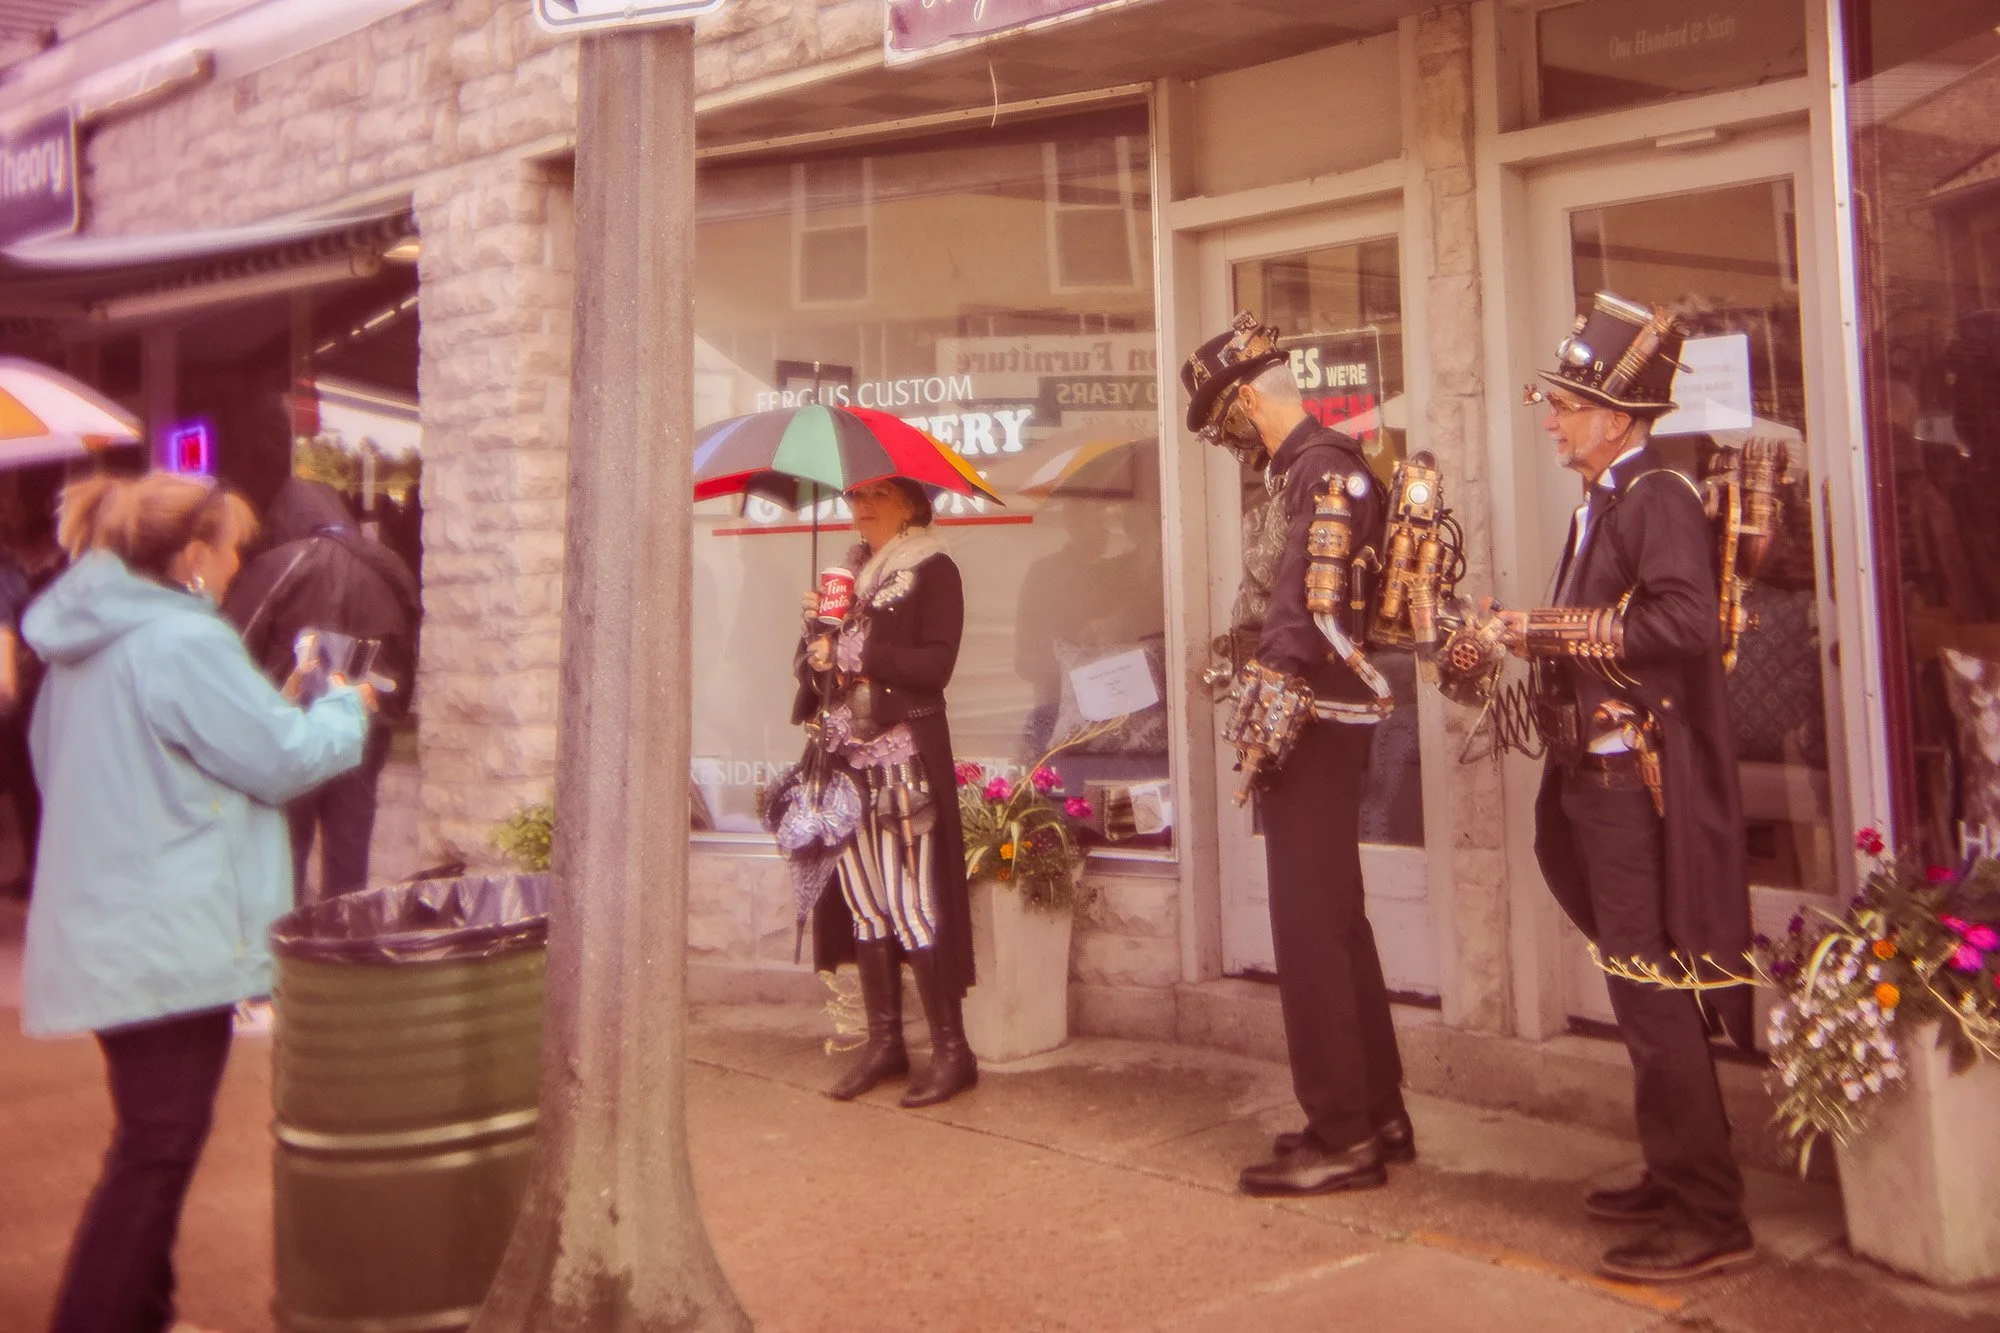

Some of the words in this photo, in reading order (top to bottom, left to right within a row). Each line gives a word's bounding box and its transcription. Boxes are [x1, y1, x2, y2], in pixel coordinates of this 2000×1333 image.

[0, 137, 65, 197] heory
[1289, 347, 1322, 389] ES
[1325, 363, 1368, 387] WE'RE
[856, 374, 974, 408] CUSTOM
[825, 578, 847, 596] Tim
[819, 595, 847, 614] Hort
